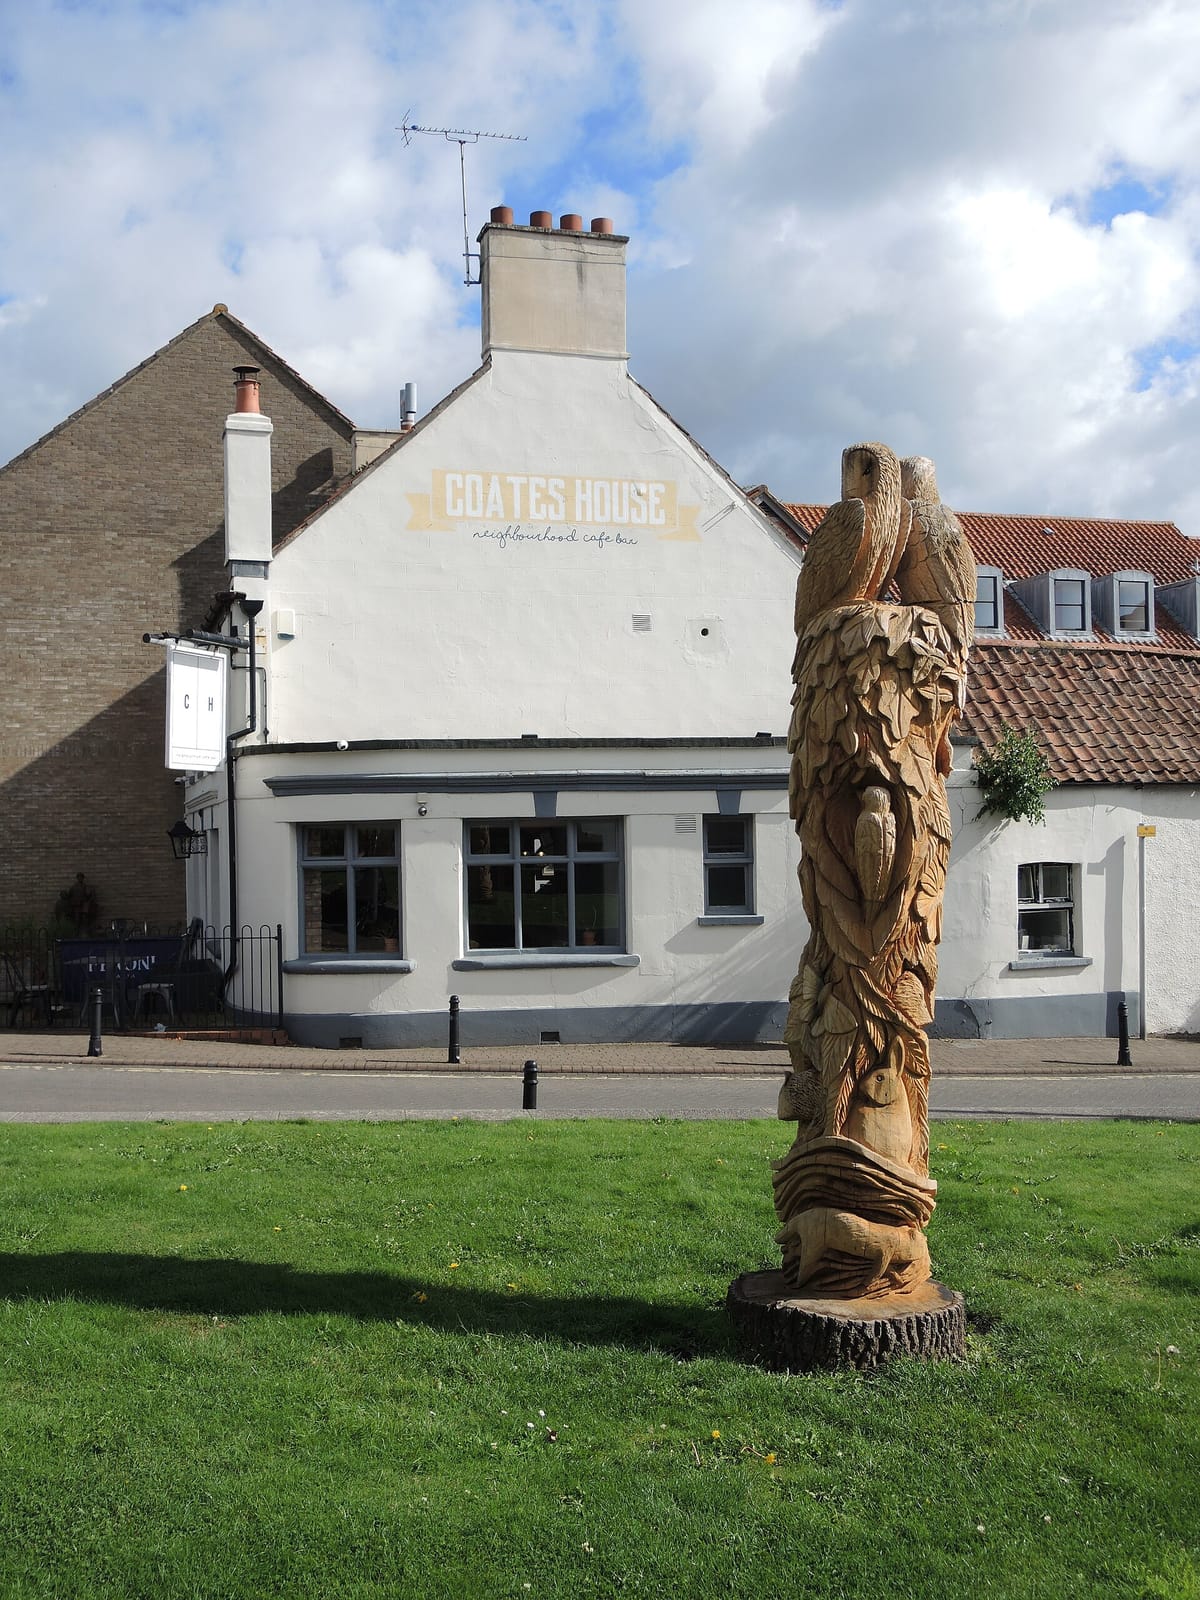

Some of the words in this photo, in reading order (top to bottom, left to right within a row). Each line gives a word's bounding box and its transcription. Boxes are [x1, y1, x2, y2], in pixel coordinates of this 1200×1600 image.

[445, 472, 567, 521] COATES
[575, 479, 667, 525] HOUSE
[472, 525, 579, 549] neighbourhood
[583, 532, 613, 549] cafe
[615, 533, 639, 545] bar
